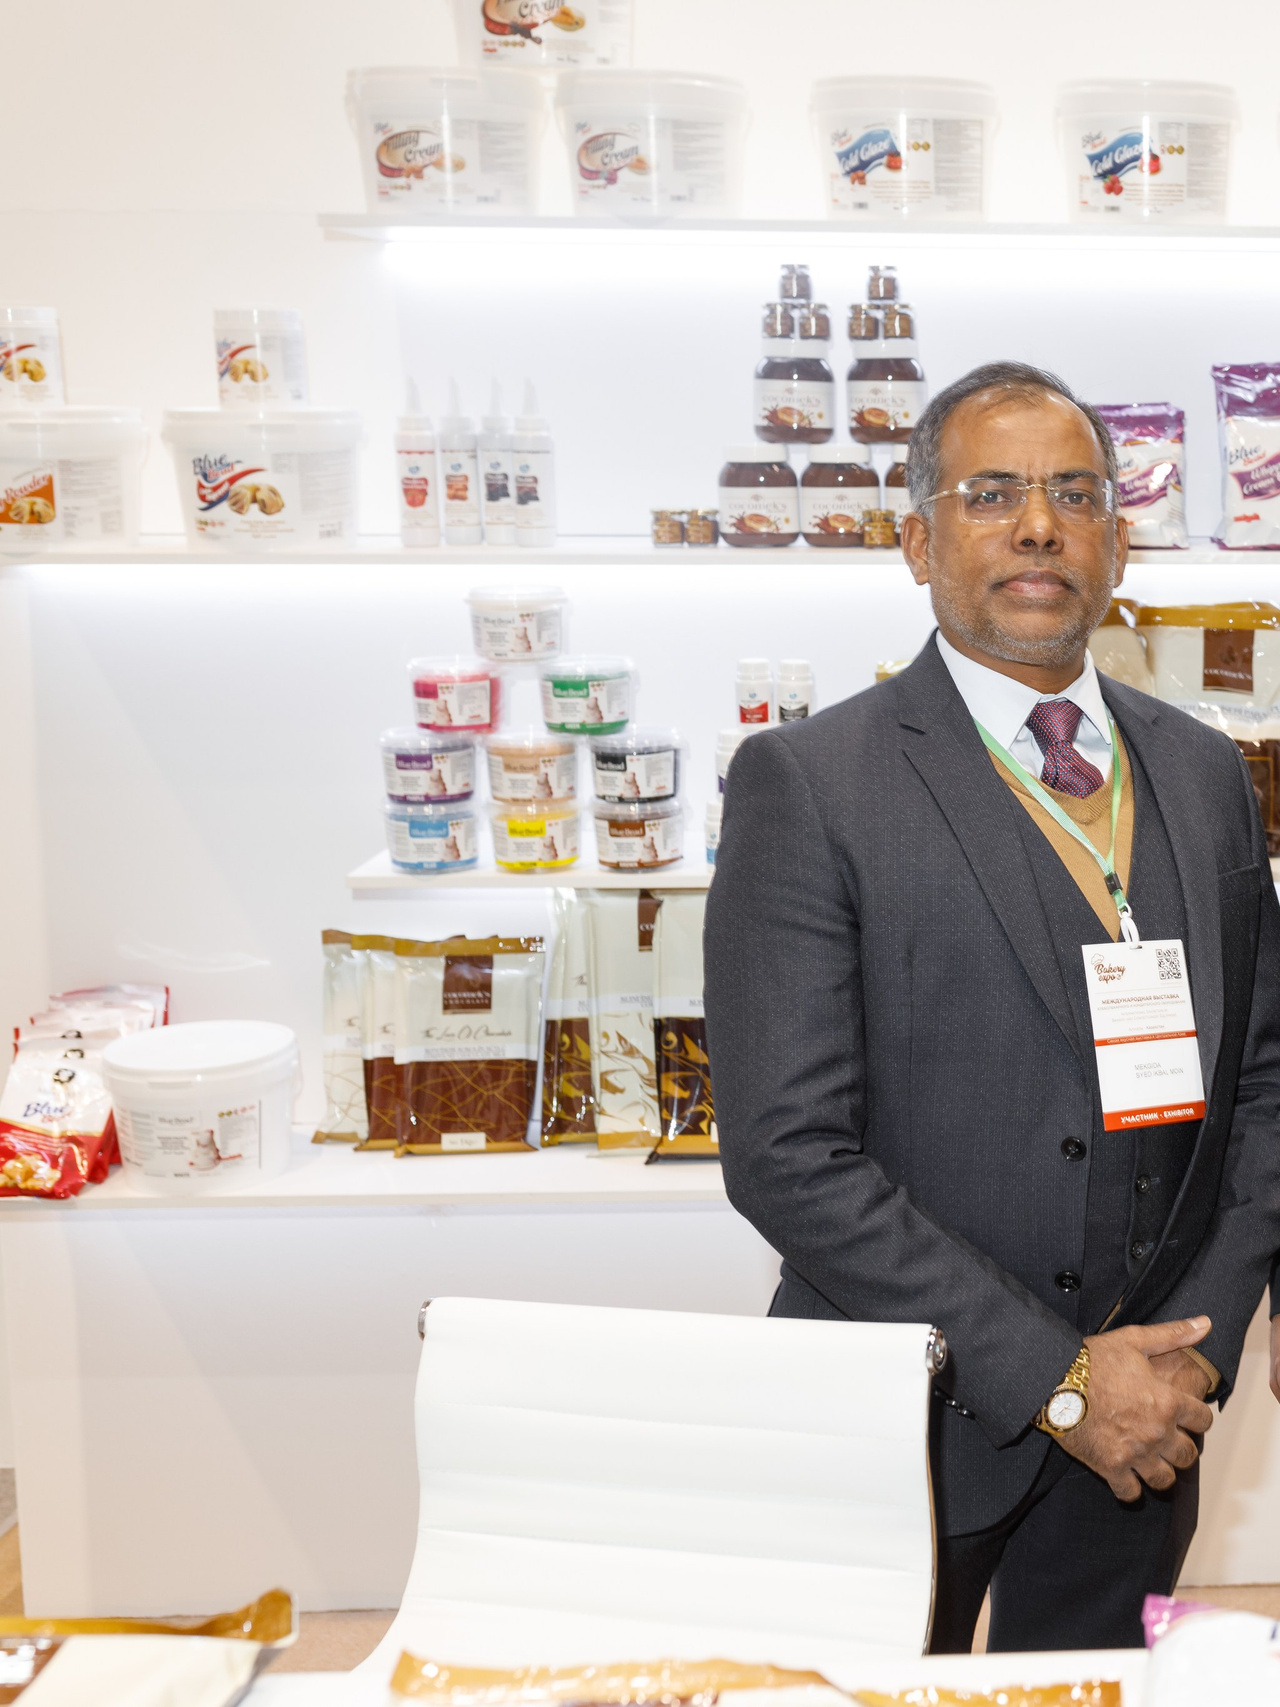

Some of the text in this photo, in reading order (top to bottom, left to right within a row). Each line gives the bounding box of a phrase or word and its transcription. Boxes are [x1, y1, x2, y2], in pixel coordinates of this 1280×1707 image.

[1114, 143, 1147, 164] Glaz
[192, 453, 227, 476] Blue
[1243, 478, 1276, 496] Cream
[1094, 963, 1126, 976] Bakery
[1098, 974, 1116, 984] expo
[1101, 993, 1180, 1005] МЕЖДУНАРОДНАЯ ВЫСТАВКА
[1134, 1062, 1161, 1071] MEKGIDA
[1136, 1070, 1152, 1079] SYED
[1120, 1112, 1159, 1125] УЧАСТНИК
[1163, 1107, 1194, 1119] EXHIBITOR
